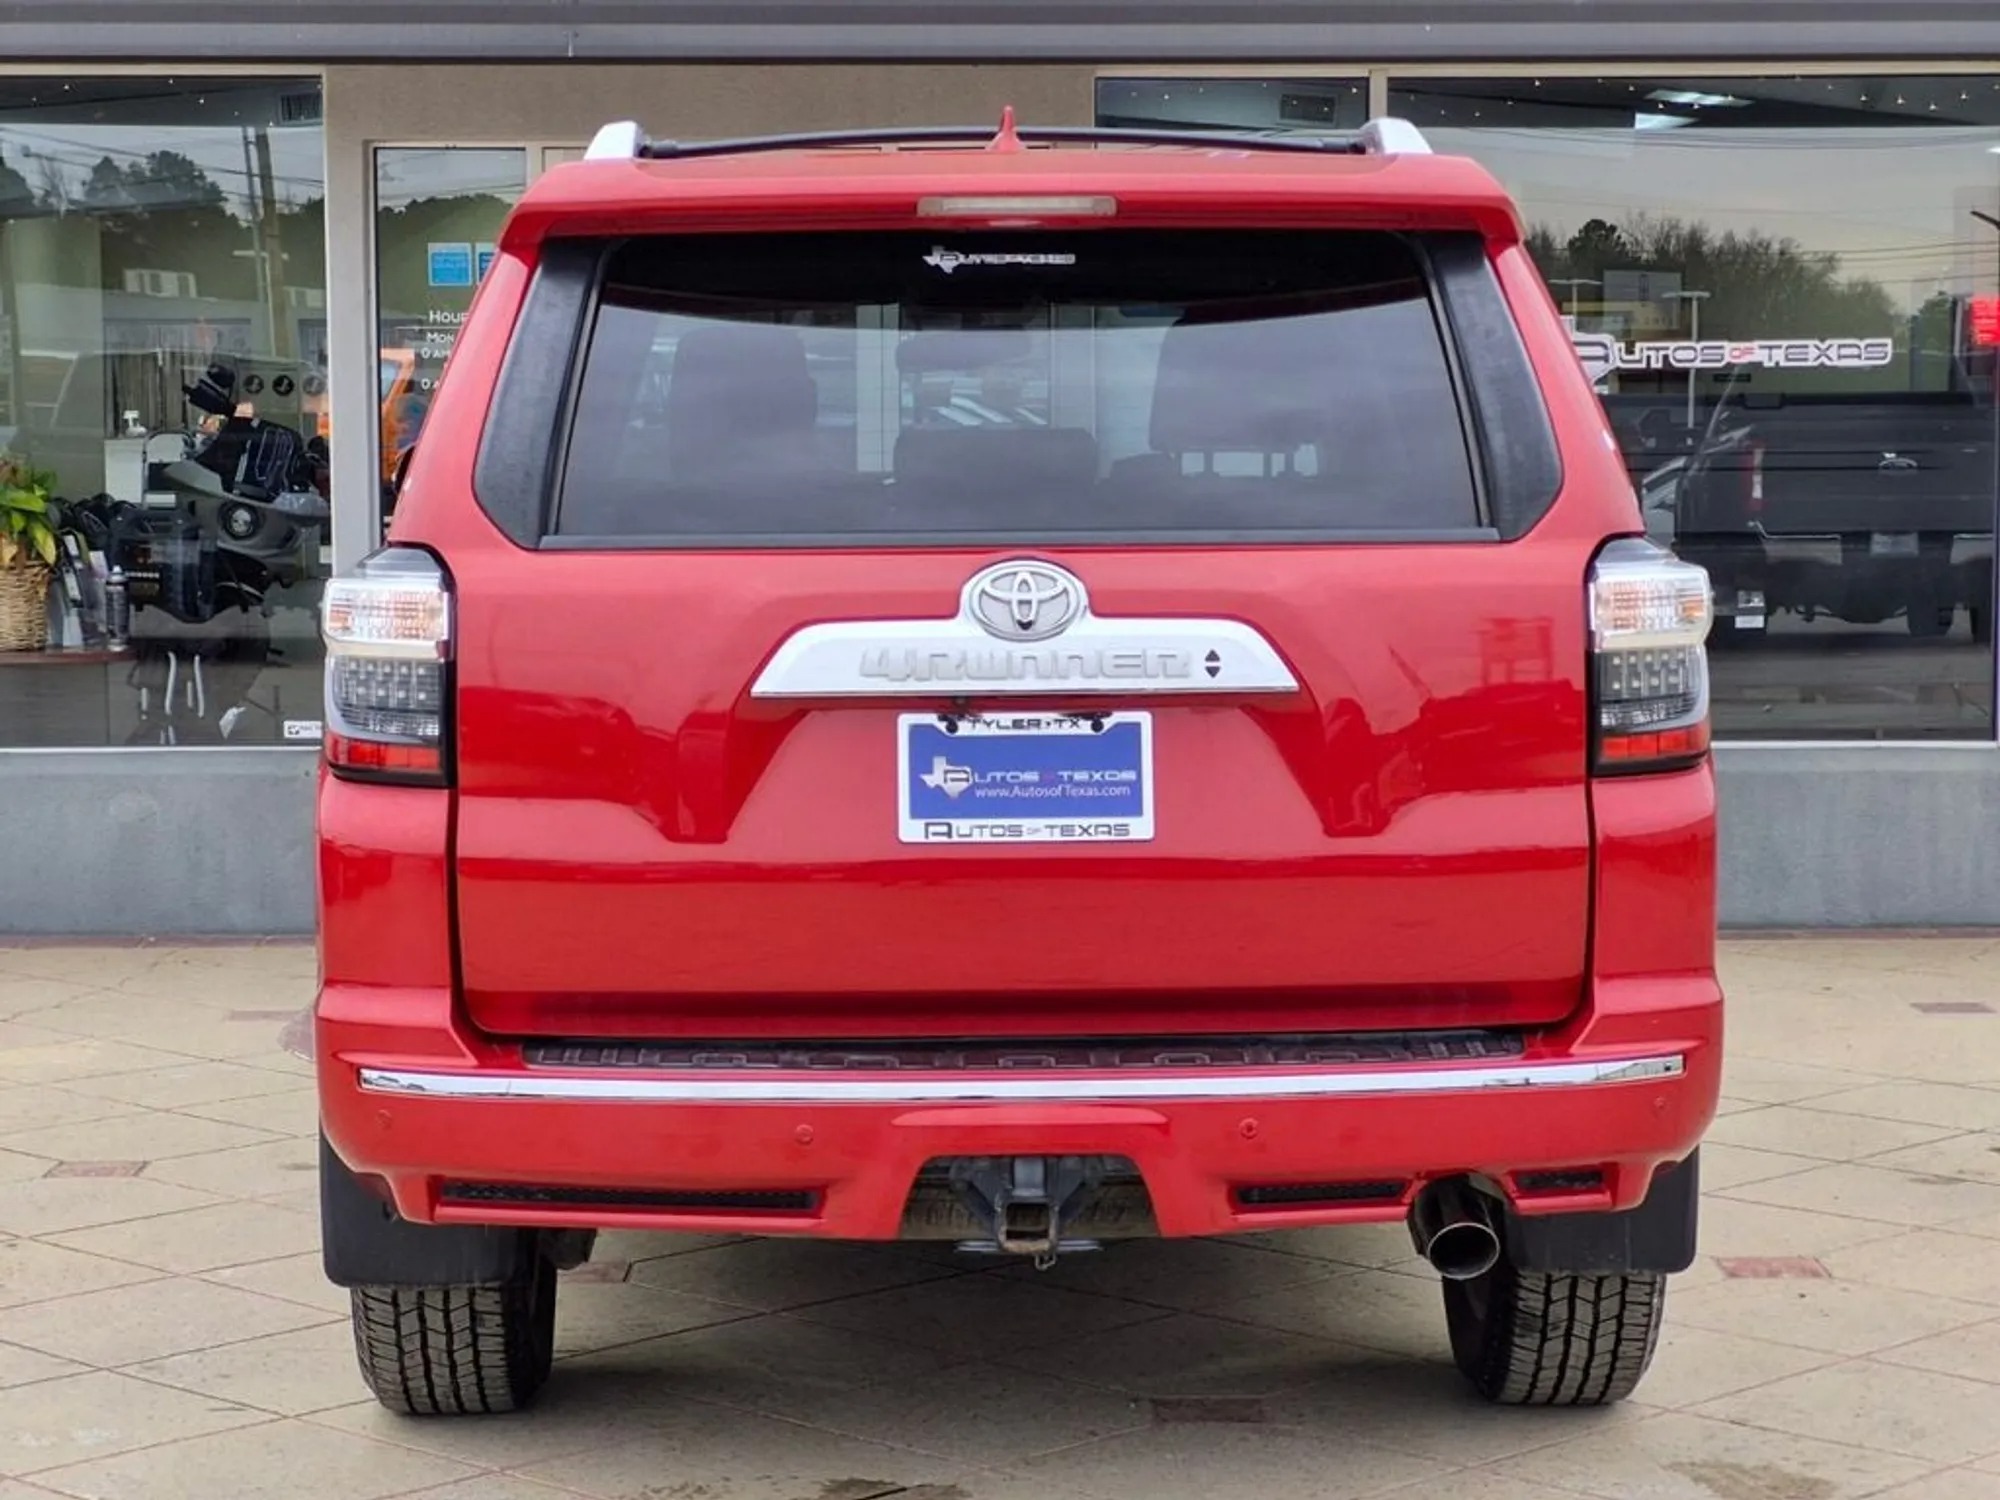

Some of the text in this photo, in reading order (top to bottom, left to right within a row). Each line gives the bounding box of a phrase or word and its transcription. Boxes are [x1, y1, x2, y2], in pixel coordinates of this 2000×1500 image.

[1758, 341, 1889, 364] TEXAS
[859, 648, 1193, 681] 4RUNNER
[969, 718, 1081, 730] TYLER TX
[974, 785, 1131, 799] www.AutosofTexas.com
[924, 821, 1024, 839] AUTOS
[1044, 823, 1131, 837] TEXAS
